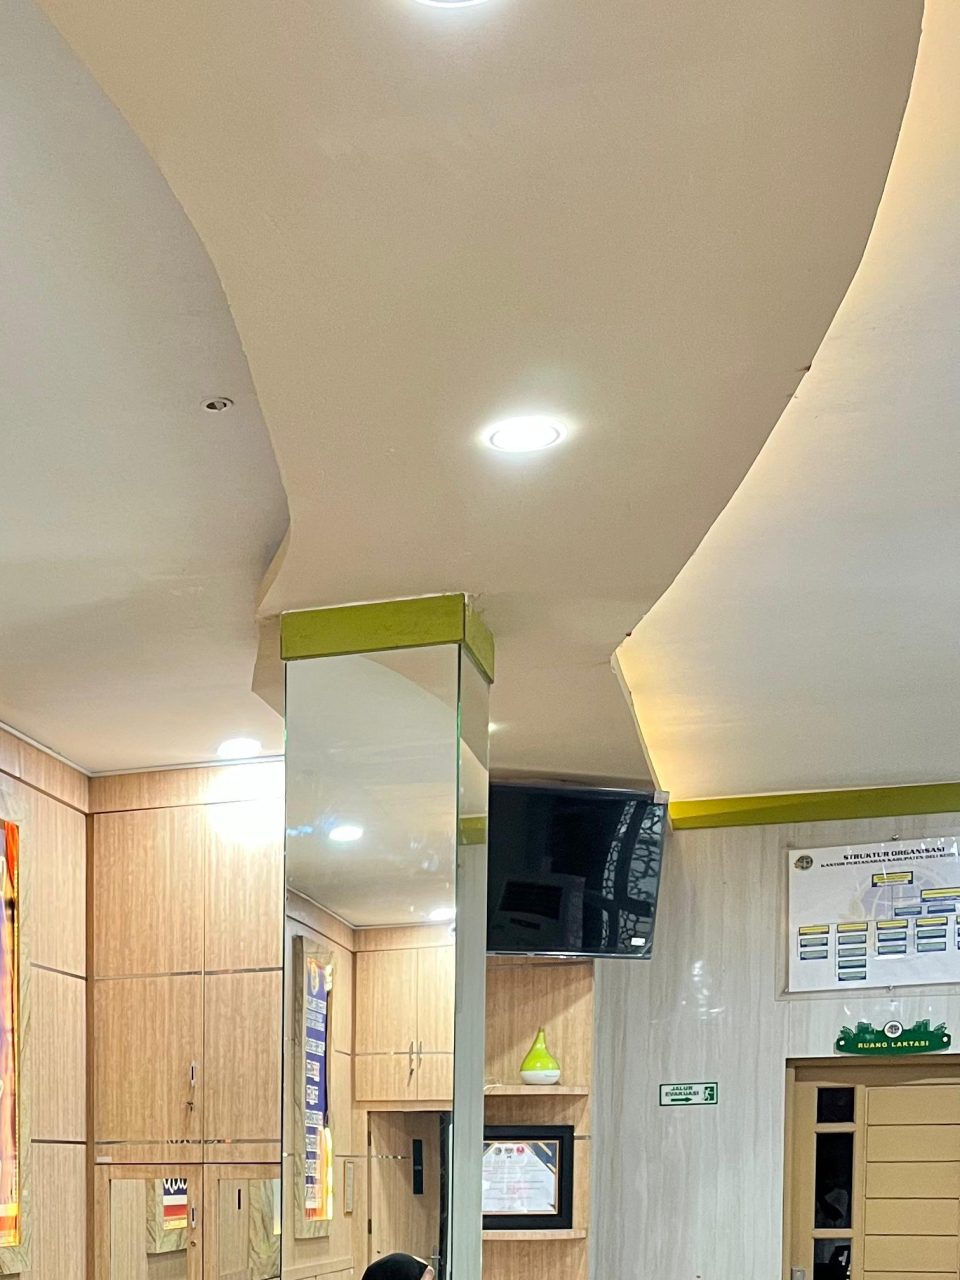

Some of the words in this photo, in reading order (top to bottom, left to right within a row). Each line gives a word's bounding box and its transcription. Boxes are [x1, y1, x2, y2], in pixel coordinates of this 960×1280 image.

[843, 851, 889, 860] STRUKTUR
[891, 846, 945, 857] ORGANISASI
[891, 1040, 929, 1048] LAKTASI
[665, 1090, 700, 1098] EVAKUASI
